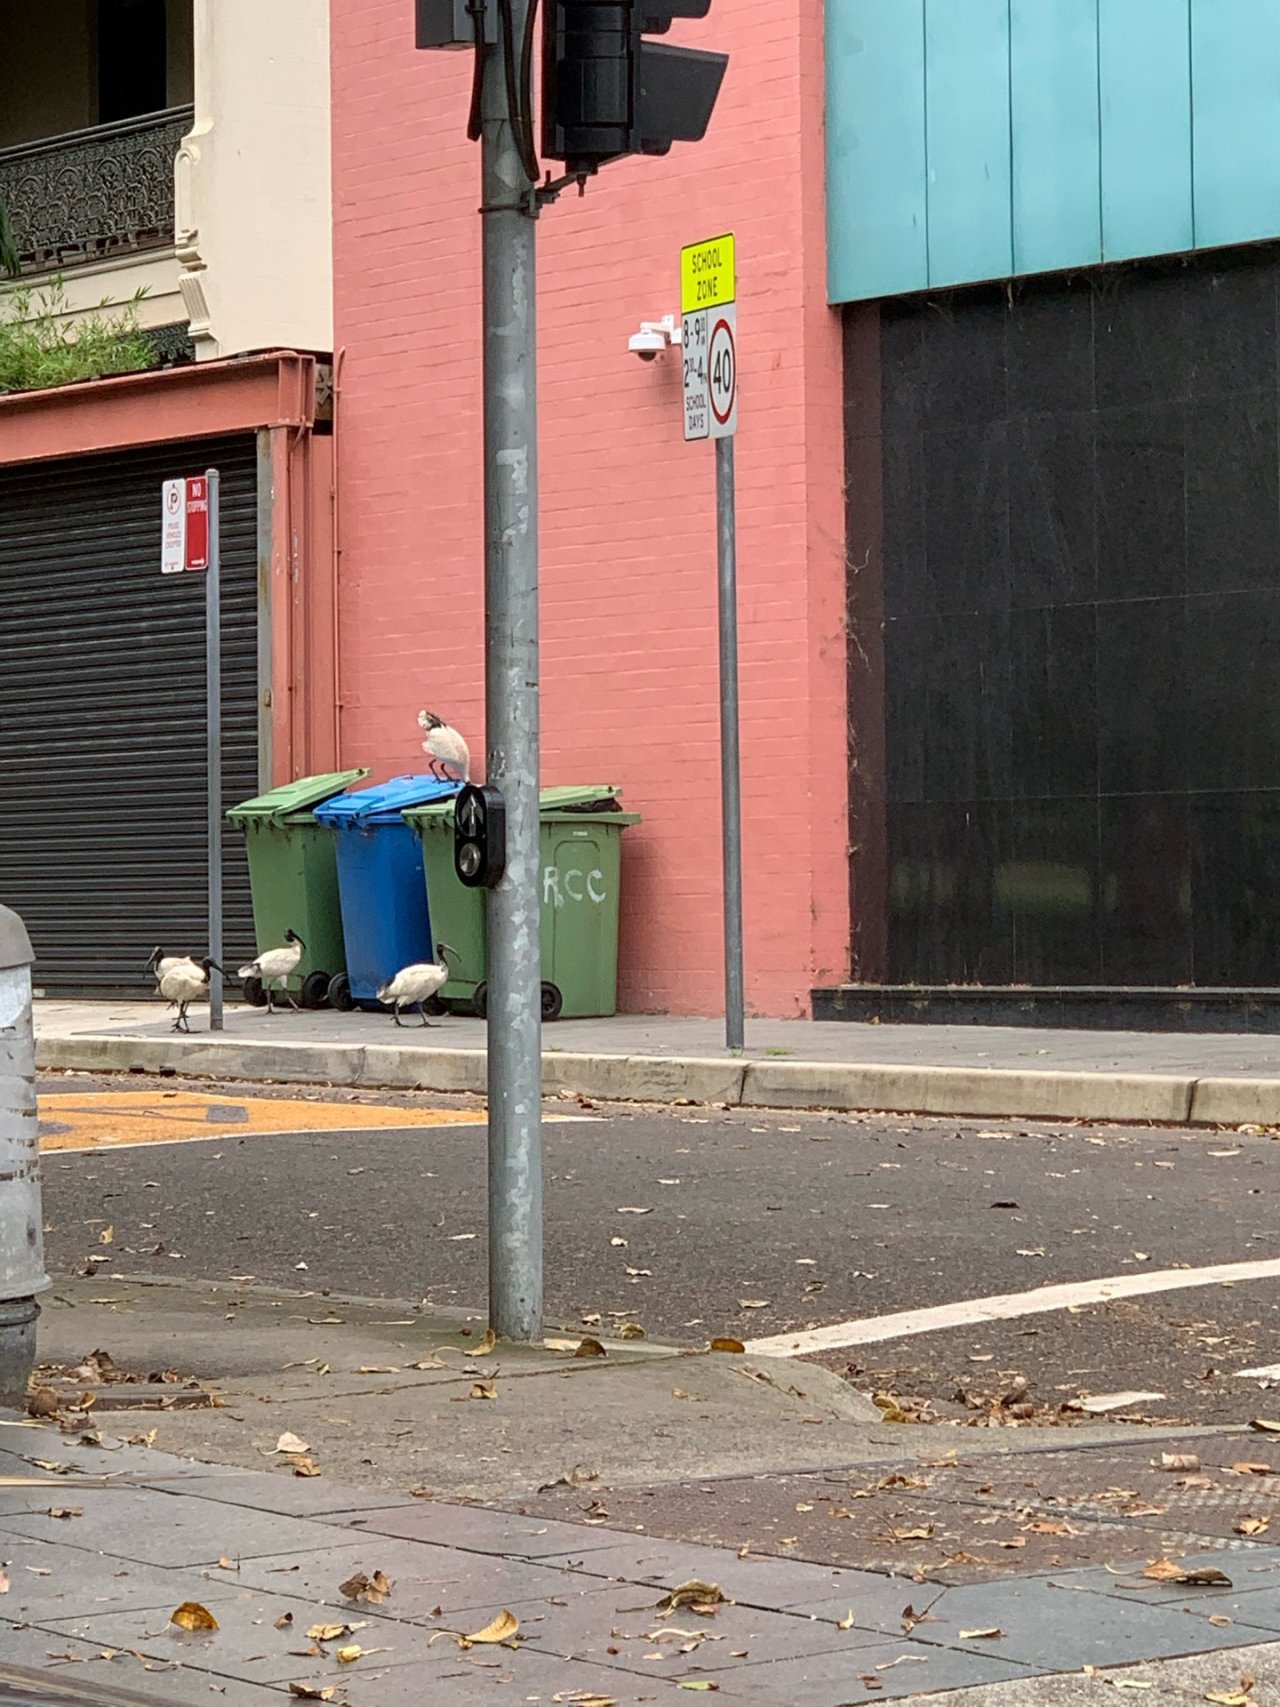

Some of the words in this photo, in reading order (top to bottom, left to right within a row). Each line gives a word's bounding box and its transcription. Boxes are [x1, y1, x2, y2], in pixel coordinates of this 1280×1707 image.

[692, 247, 722, 275] SCHOOL
[697, 276, 718, 301] ZONE
[713, 347, 731, 395] 40
[686, 393, 706, 411] SCHOOL
[689, 413, 704, 430] DAYS
[192, 482, 202, 498] NO
[187, 500, 208, 514] STOPPING
[543, 866, 606, 908] RCC
